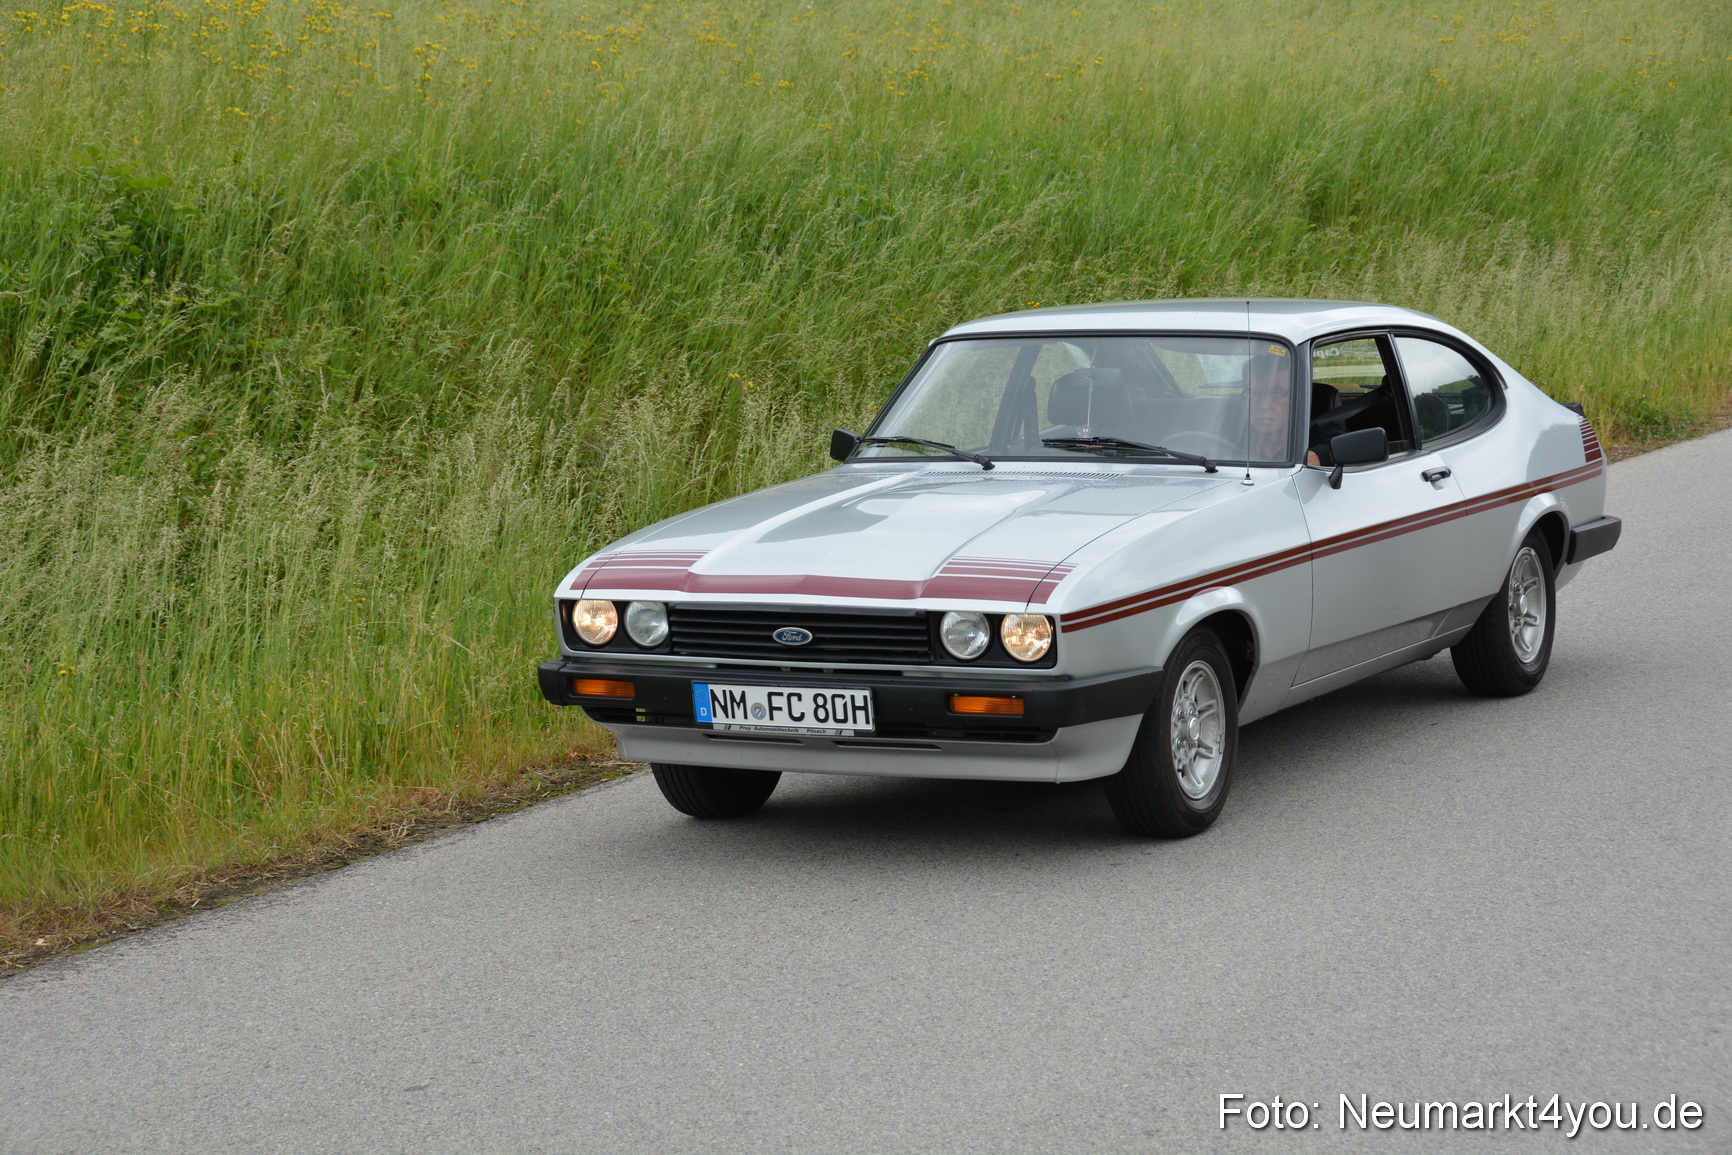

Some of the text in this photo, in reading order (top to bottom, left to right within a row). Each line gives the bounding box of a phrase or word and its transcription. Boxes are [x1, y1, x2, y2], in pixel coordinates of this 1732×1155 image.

[781, 630, 803, 641] Ford
[700, 707, 708, 716] D
[710, 688, 870, 725] NM FC 80H
[753, 726, 800, 734] Automobiltechnik
